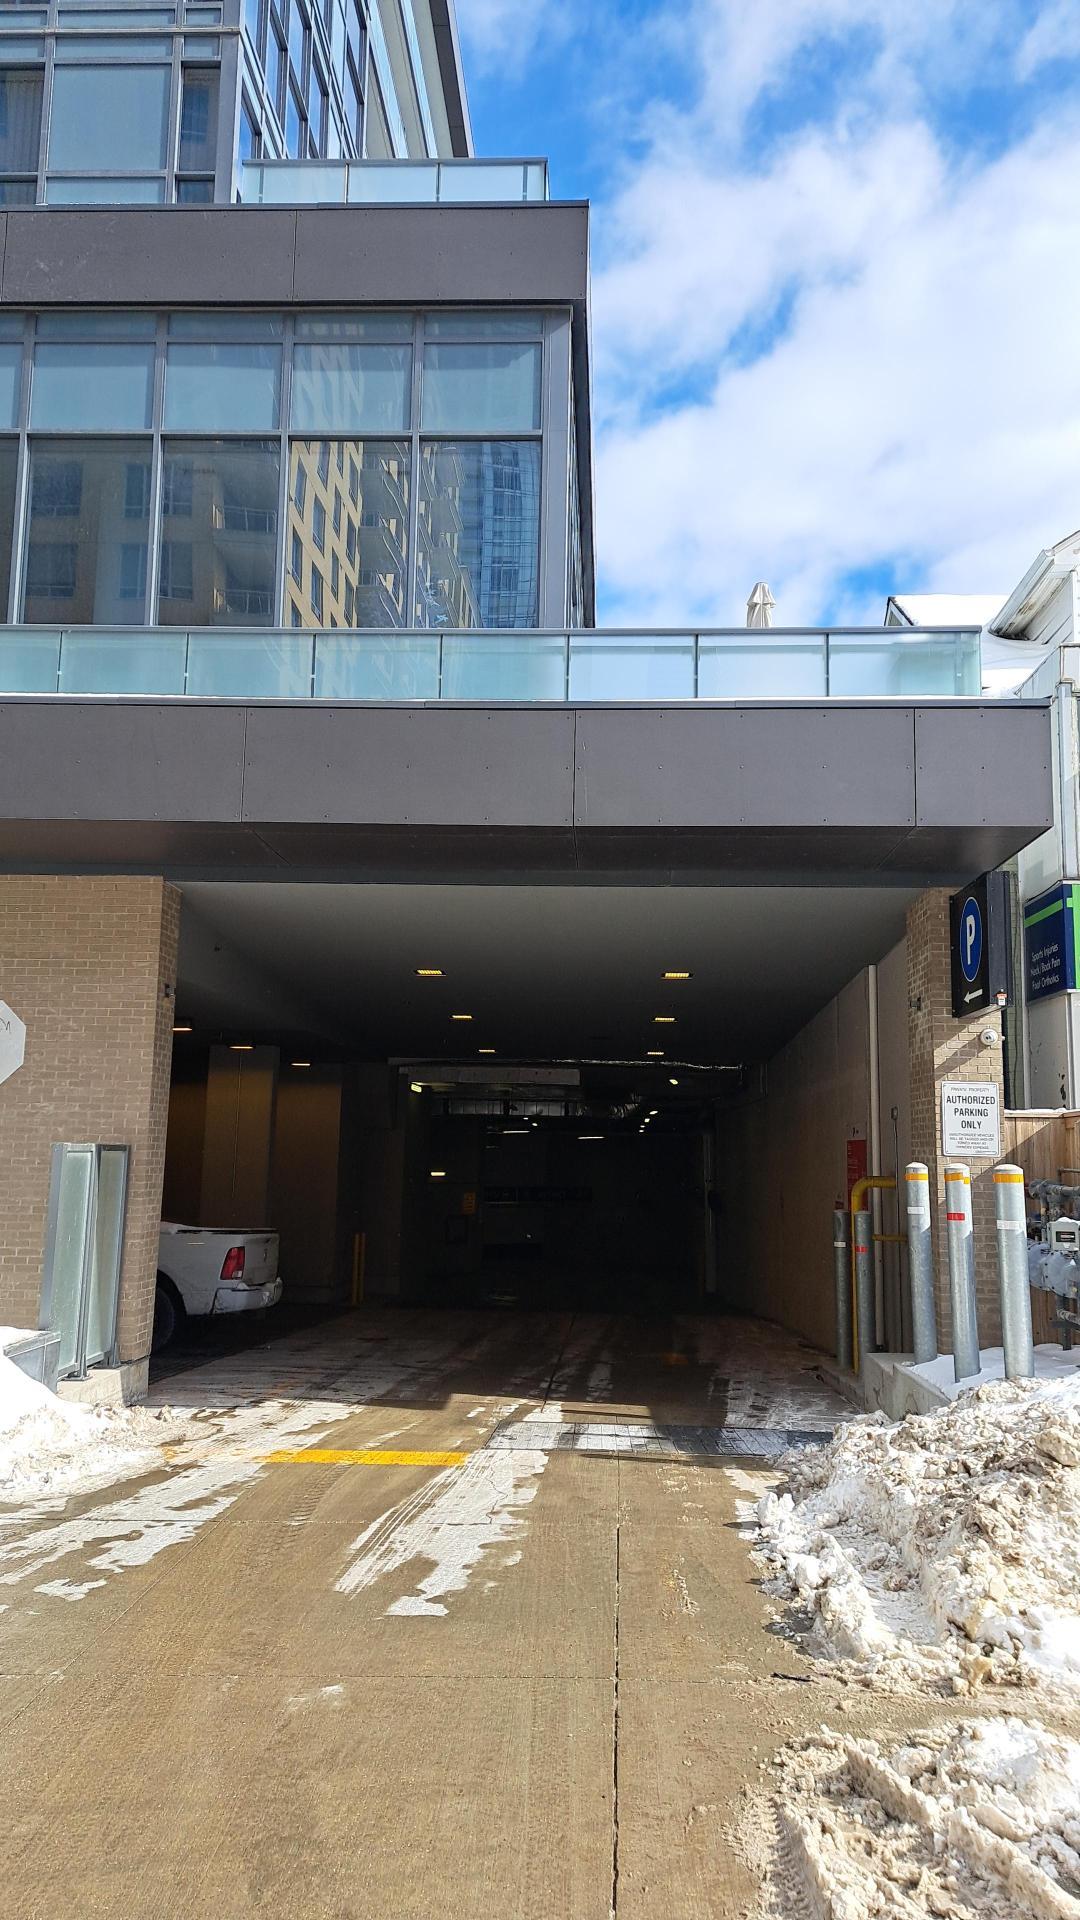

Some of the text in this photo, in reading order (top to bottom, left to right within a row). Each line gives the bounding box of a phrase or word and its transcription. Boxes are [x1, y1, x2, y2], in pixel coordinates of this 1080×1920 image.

[966, 914, 976, 965] P
[1032, 943, 1059, 961] Sports Injuries
[1051, 956, 1060, 968] Pain
[946, 1095, 996, 1105] AUTHORIZED
[954, 1107, 989, 1117] PARKING
[961, 1120, 982, 1130] ONLY
